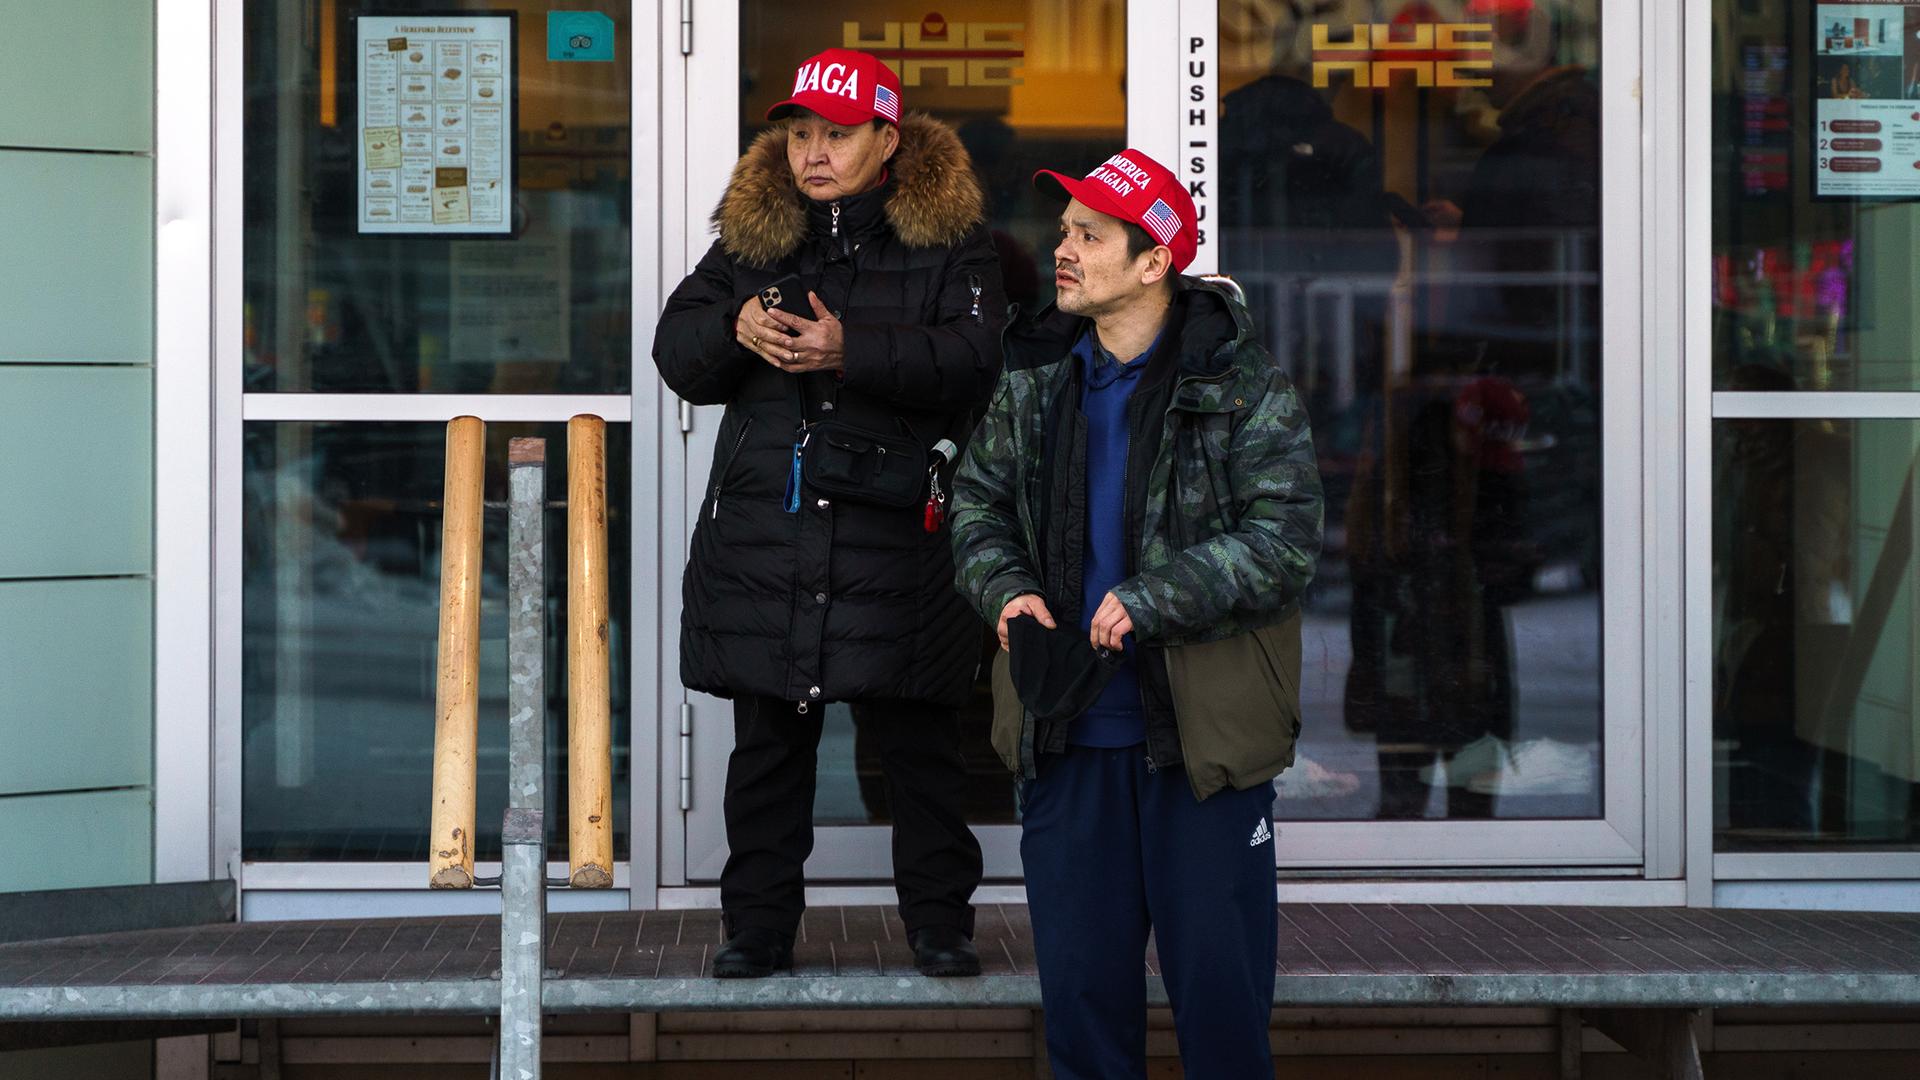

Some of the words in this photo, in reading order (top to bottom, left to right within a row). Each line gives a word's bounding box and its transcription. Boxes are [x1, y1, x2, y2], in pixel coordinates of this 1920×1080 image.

[1189, 37, 1206, 126] PUSH
[1820, 138, 1828, 150] 2
[1820, 157, 1828, 169] 3
